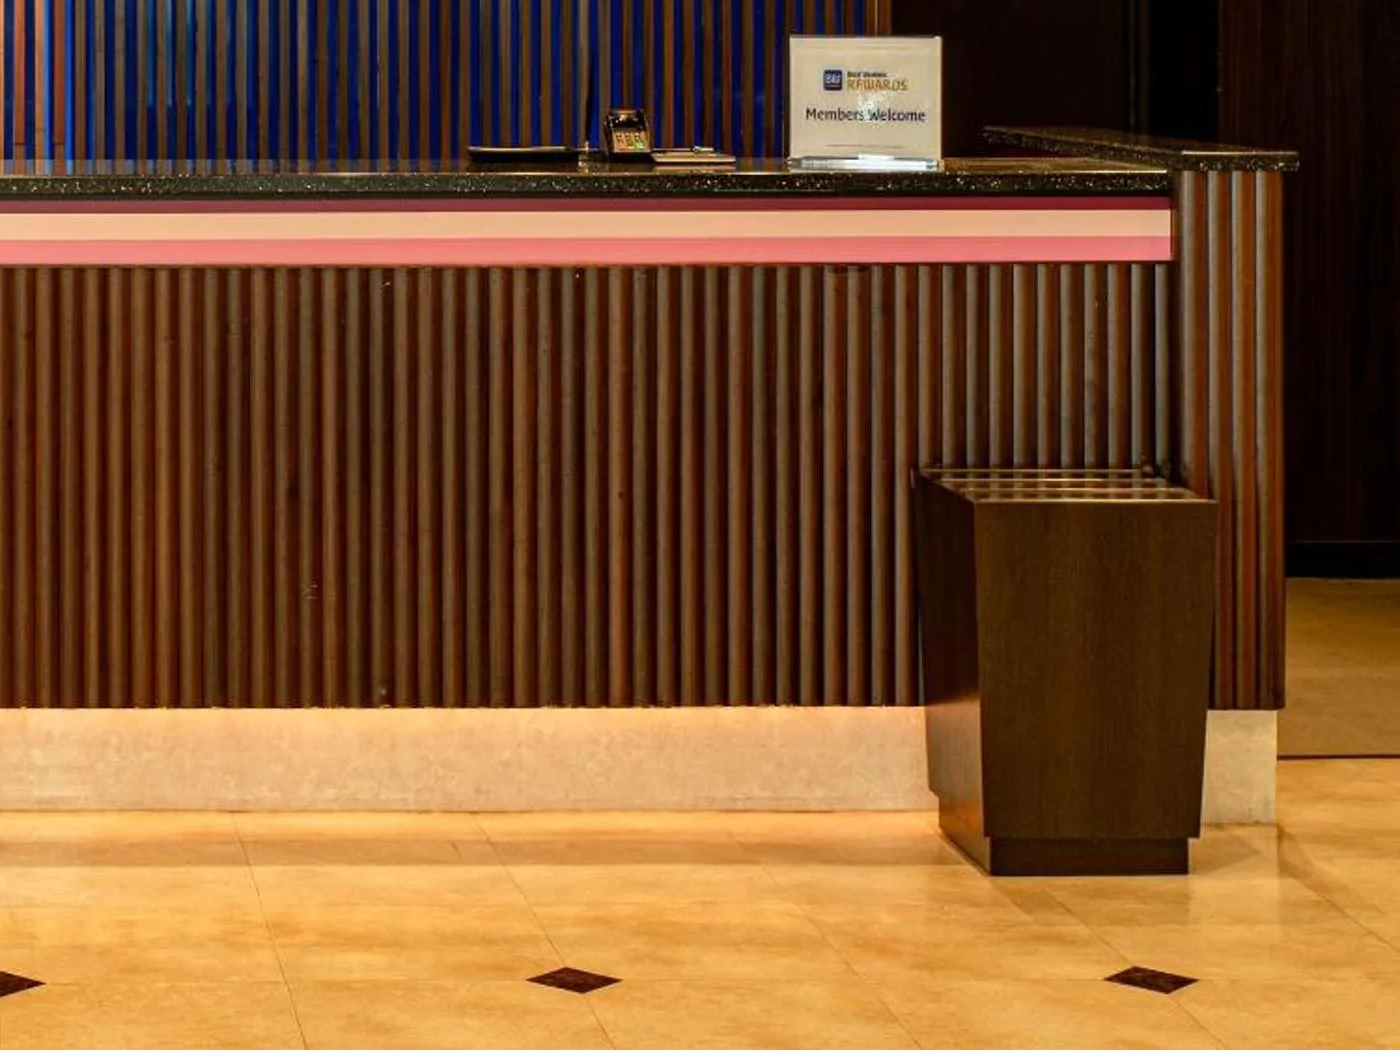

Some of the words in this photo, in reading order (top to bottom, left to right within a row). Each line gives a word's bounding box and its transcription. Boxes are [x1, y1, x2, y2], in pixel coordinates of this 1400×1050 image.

[847, 79, 909, 91] REWARDS
[806, 107, 864, 121] Members
[868, 107, 926, 121] Welcome
